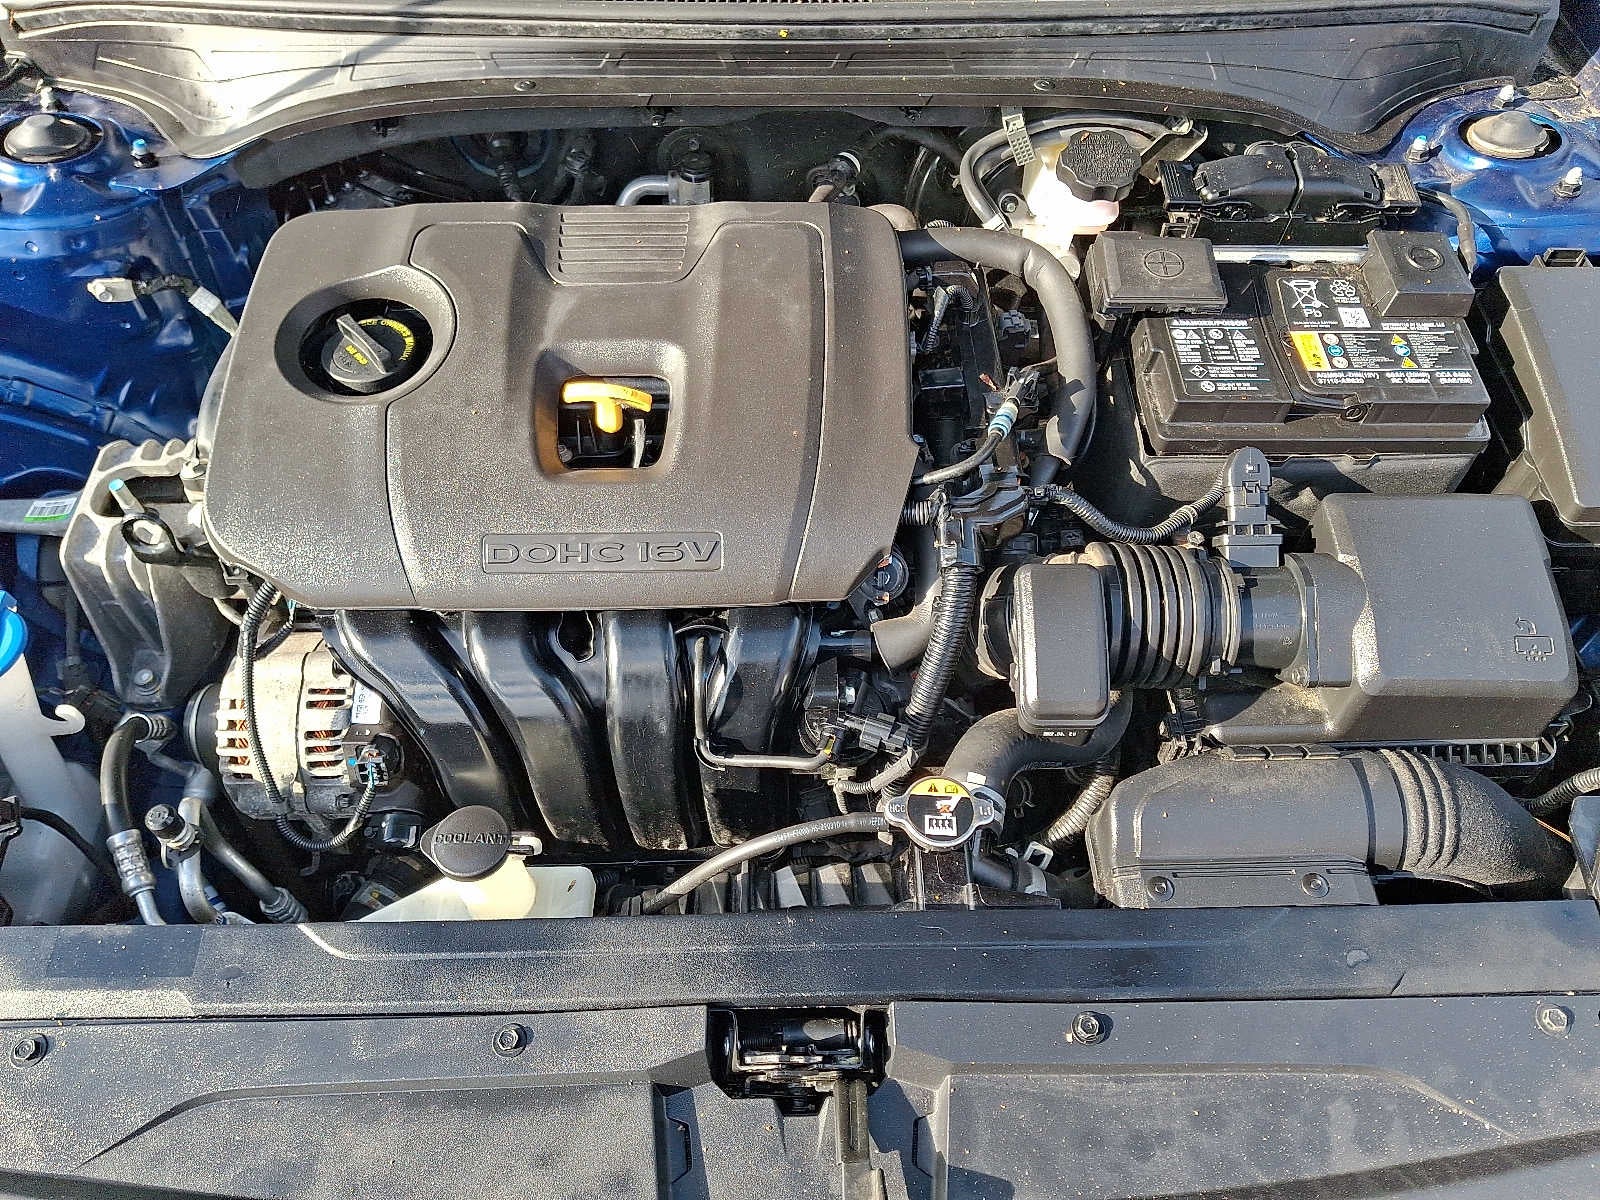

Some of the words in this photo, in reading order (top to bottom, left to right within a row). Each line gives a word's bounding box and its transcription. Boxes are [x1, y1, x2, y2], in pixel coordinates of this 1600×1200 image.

[486, 541, 624, 565] DOHC
[637, 540, 720, 563] 16V
[435, 832, 504, 845] COOLANT
